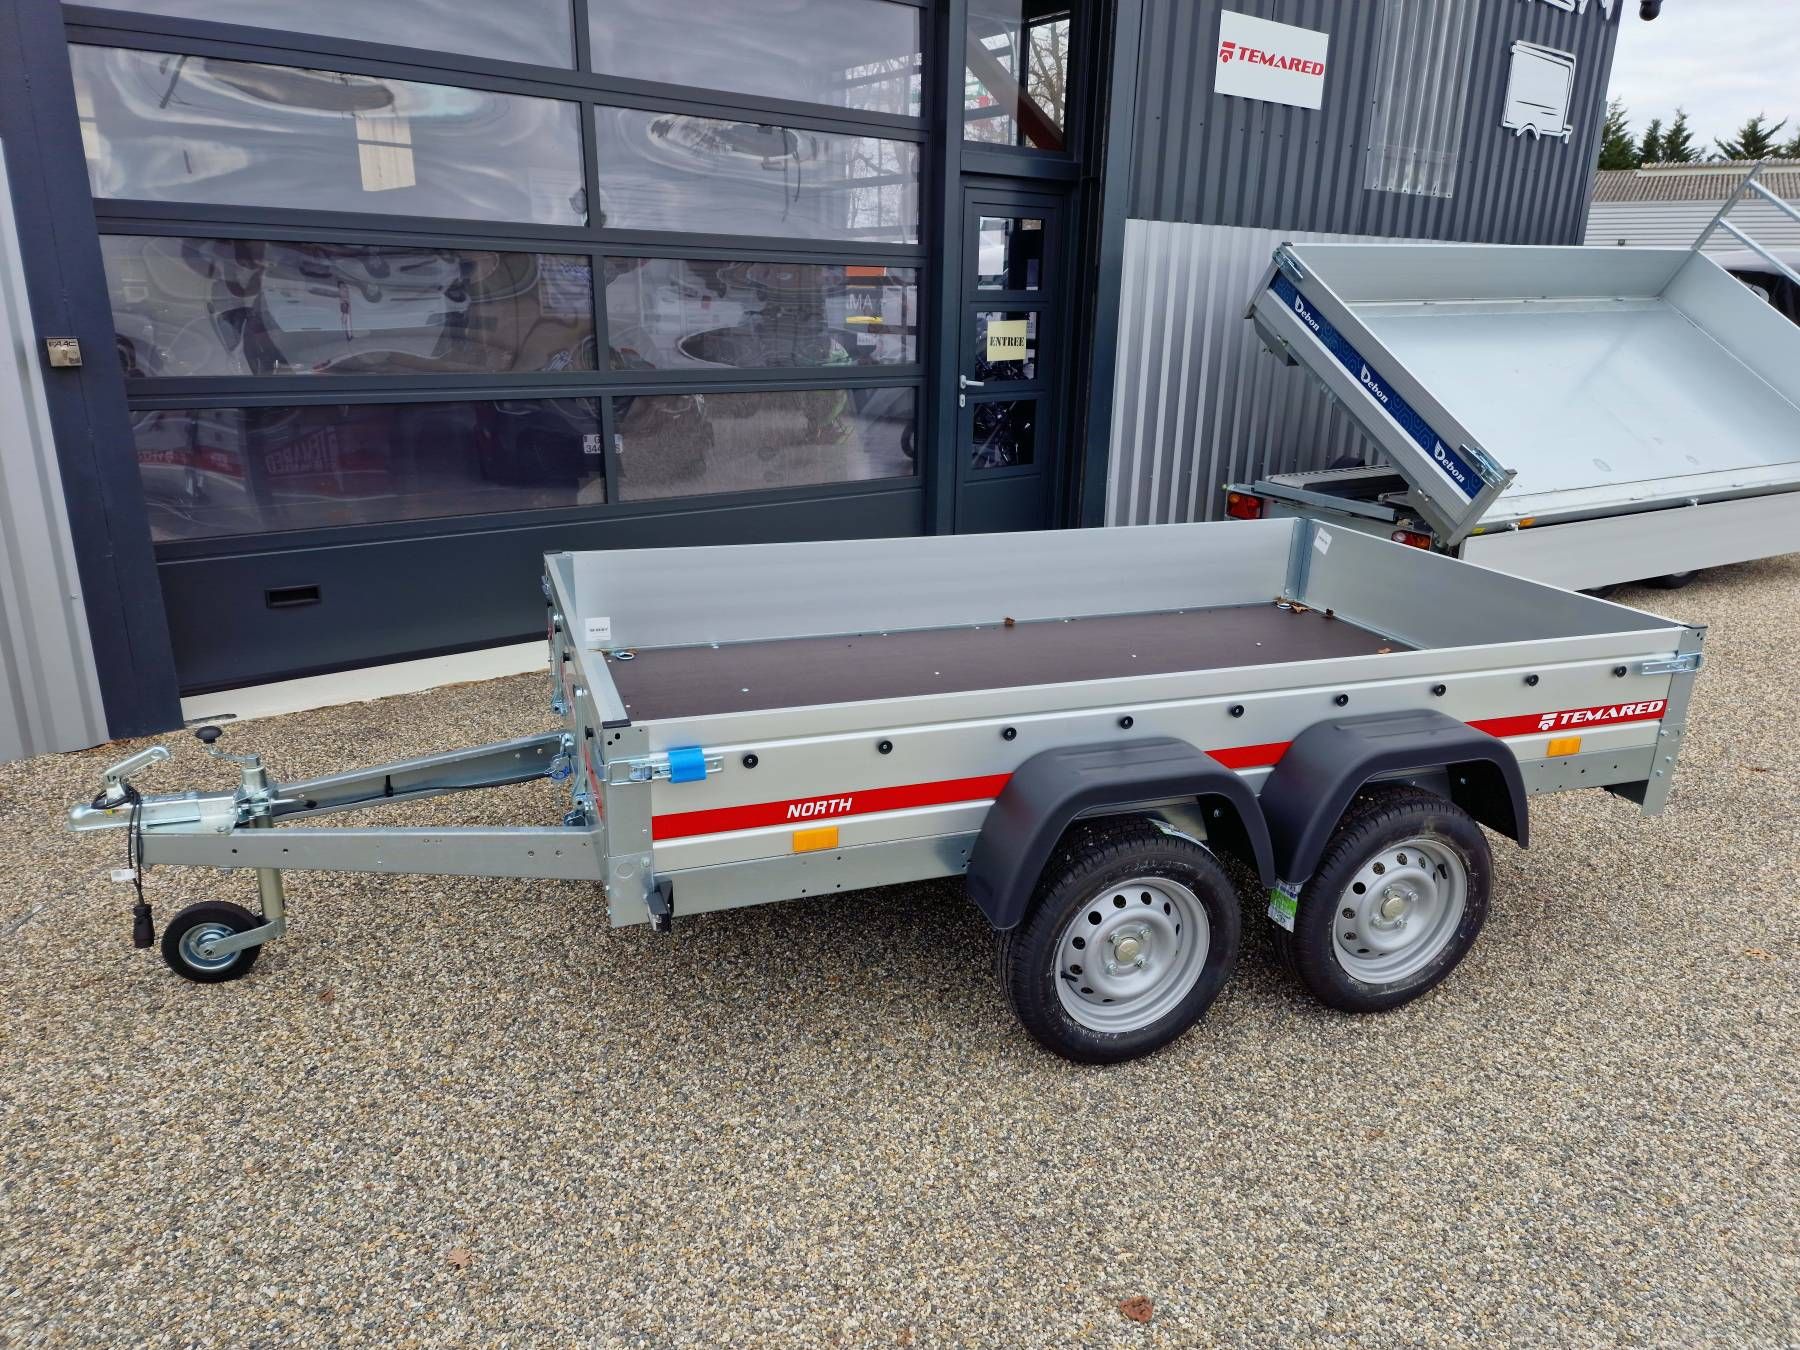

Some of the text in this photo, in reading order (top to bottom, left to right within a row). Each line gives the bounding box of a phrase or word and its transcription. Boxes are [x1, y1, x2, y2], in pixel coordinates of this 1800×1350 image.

[1239, 46, 1324, 76] TEMARED
[1294, 294, 1320, 331] Debon
[990, 336, 1024, 346] ENTREE
[1360, 363, 1388, 403] Debon
[1434, 439, 1465, 483] Debon
[1560, 700, 1664, 725] TEMARED
[786, 797, 853, 818] NORTH
